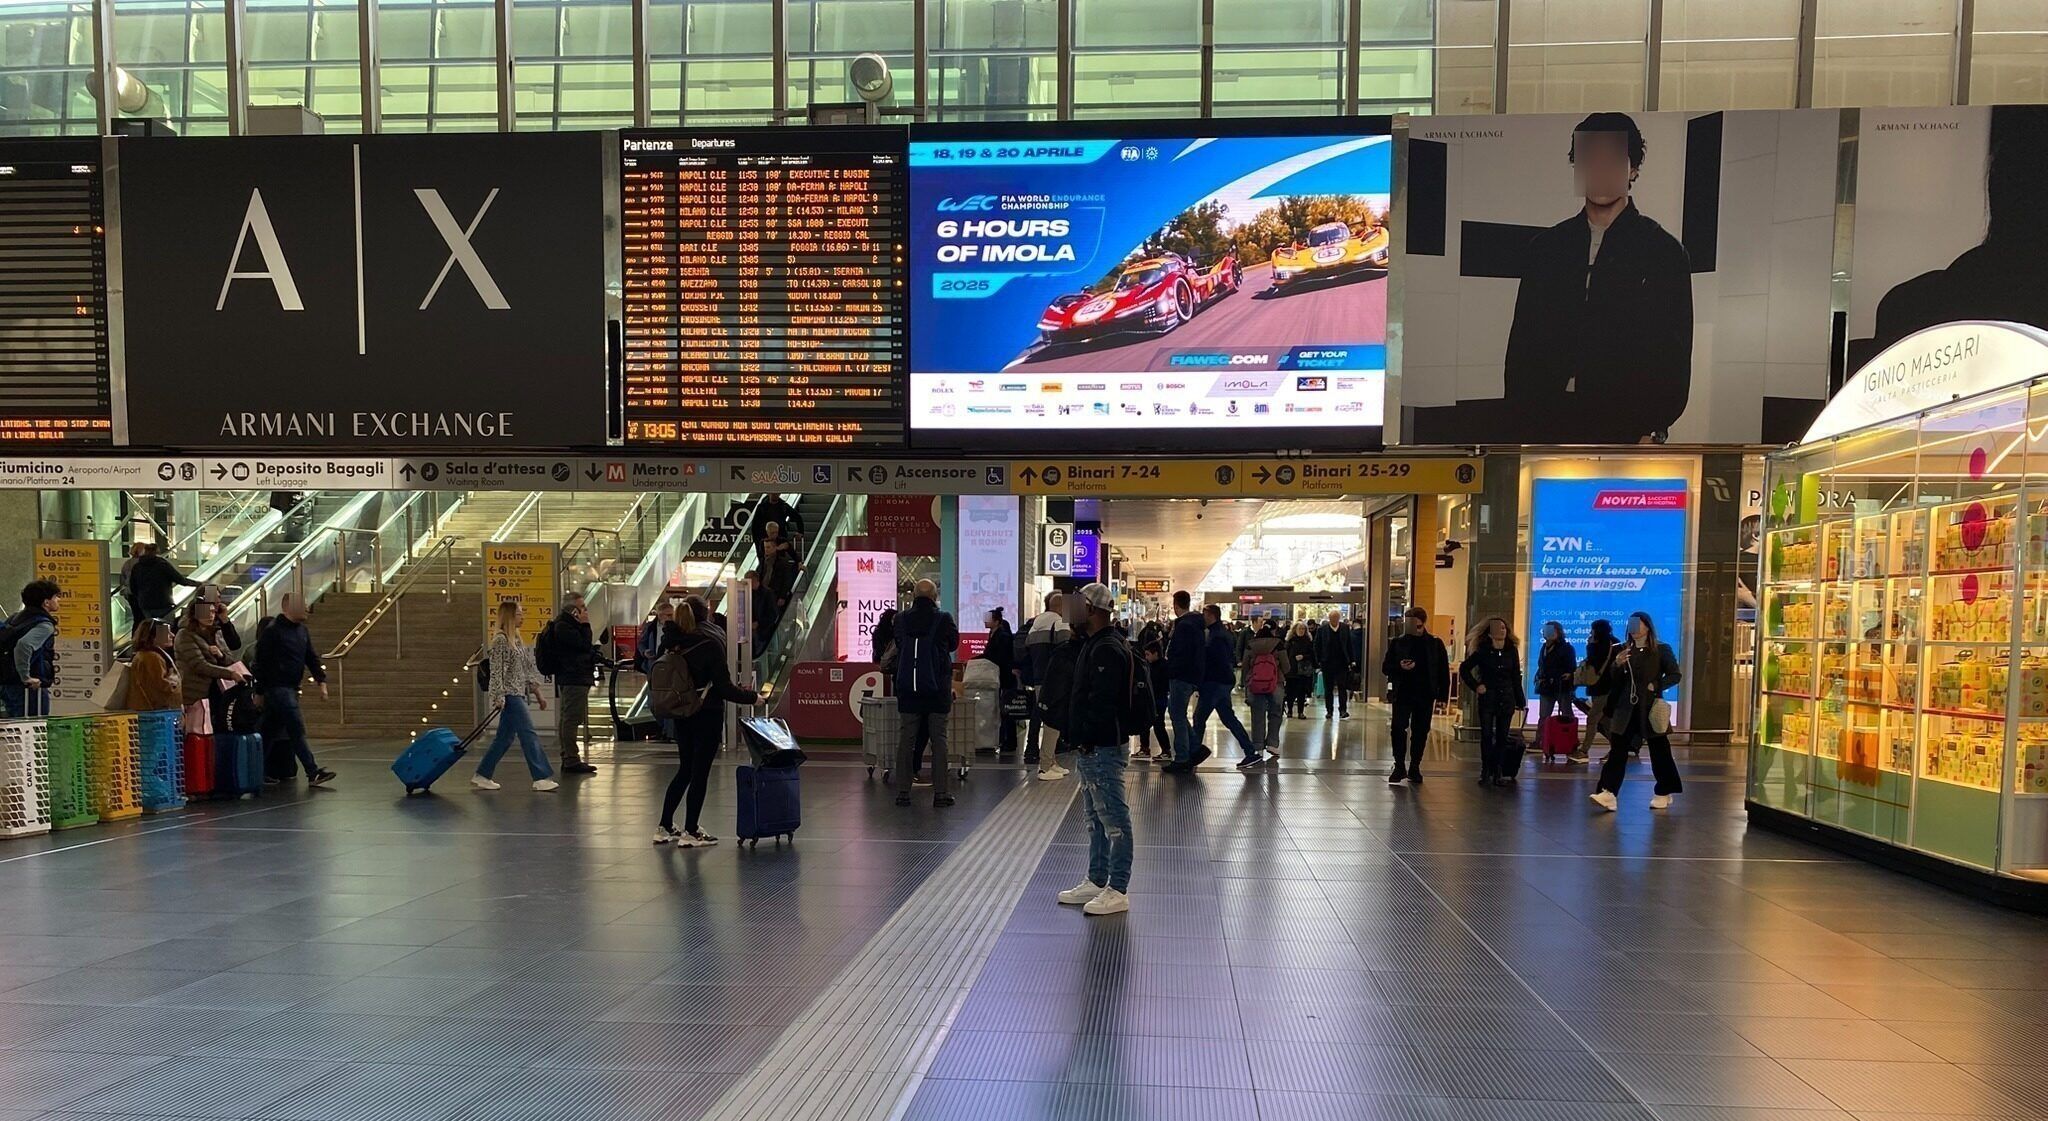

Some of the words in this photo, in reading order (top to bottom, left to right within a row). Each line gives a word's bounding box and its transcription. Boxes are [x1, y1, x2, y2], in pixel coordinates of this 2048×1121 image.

[1913, 122, 1960, 130] EXCHANGE
[1460, 130, 1504, 138] EXCHANGE
[624, 139, 674, 151] Partenze
[692, 138, 736, 150] Departures
[933, 149, 954, 160] 18,
[958, 149, 976, 158] 19
[980, 148, 992, 158] &
[996, 148, 1020, 158] 20
[1023, 147, 1084, 158] APRILE
[1121, 147, 1140, 161] FIA
[680, 171, 706, 180] NAPOLI
[790, 170, 830, 179] EXECUTIVE
[834, 170, 840, 178] E
[844, 170, 870, 178] BUSINE
[680, 183, 706, 192] NAPOLI
[840, 182, 868, 190] NAPOLI
[680, 195, 706, 204] NAPOLI
[937, 194, 998, 211] WEC
[1052, 194, 1106, 202] ENDURANCE
[680, 208, 706, 216] MILANO
[837, 206, 864, 214] MILANO
[872, 206, 878, 214] 3
[1002, 202, 1070, 210] CHAMPIONSHIP
[680, 220, 706, 228] NAPOLI
[838, 219, 869, 228] EXECUTI
[937, 220, 958, 238] 6
[962, 220, 1070, 238] HOURS
[214, 186, 305, 311] A
[412, 187, 512, 310] X
[680, 244, 698, 252] BARI
[937, 245, 978, 262] OF
[982, 244, 1076, 262] IMOLA
[680, 256, 707, 264] MILANO
[872, 255, 878, 264] 2
[680, 268, 710, 276] ISERNIA
[834, 268, 863, 276] ISERNIA
[680, 280, 718, 288] AVEZZANO
[941, 280, 990, 291] 2025
[76, 306, 86, 314] 24
[1318, 350, 1348, 358] YOUR
[1170, 354, 1268, 366] FIAWEC.COM
[1864, 362, 1906, 394] IGINIO
[1910, 334, 1980, 377] MASSARI
[1878, 389, 1898, 402] ALTA
[1901, 371, 1958, 398] PASTICCERIA
[219, 412, 336, 436] ARMANI
[352, 412, 514, 436] EXCHANGE
[644, 424, 676, 438] 13:05
[68, 464, 142, 476] Aeroporto/Airport
[256, 462, 322, 476] Deposito
[326, 462, 384, 476] Bagagli
[446, 462, 480, 475] Sala
[483, 462, 546, 475] d'attesa
[608, 465, 624, 480] M
[632, 464, 679, 476] Metro
[686, 466, 695, 474] A
[895, 466, 976, 479] Ascensore
[1068, 466, 1115, 479] Binari
[1122, 466, 1160, 478] 7-24
[1302, 464, 1351, 477] Binari
[1358, 464, 1411, 478] 25-29
[0, 476, 60, 486] inario/Platform
[62, 476, 76, 485] 24
[256, 477, 270, 486] Left
[273, 477, 308, 488] Luggage
[446, 477, 479, 488] Waiting
[481, 478, 505, 486] Room
[632, 478, 688, 488] Underground
[894, 480, 907, 490] Lift
[1068, 480, 1106, 491] Platforms
[1302, 480, 1343, 490] Platforms
[1601, 494, 1647, 506] NOVITÀ
[1542, 536, 1582, 552] ZYN
[43, 548, 76, 557] Uscite
[77, 550, 92, 558] Exits
[494, 550, 528, 560] Uscite
[1640, 566, 1672, 575] fumo.
[1542, 580, 1576, 588] Anche
[1580, 580, 1590, 588] in
[1594, 580, 1638, 590] viaggio.
[74, 590, 94, 598] Trains
[858, 612, 874, 624] IN
[122, 756, 130, 790] PLASTICA
